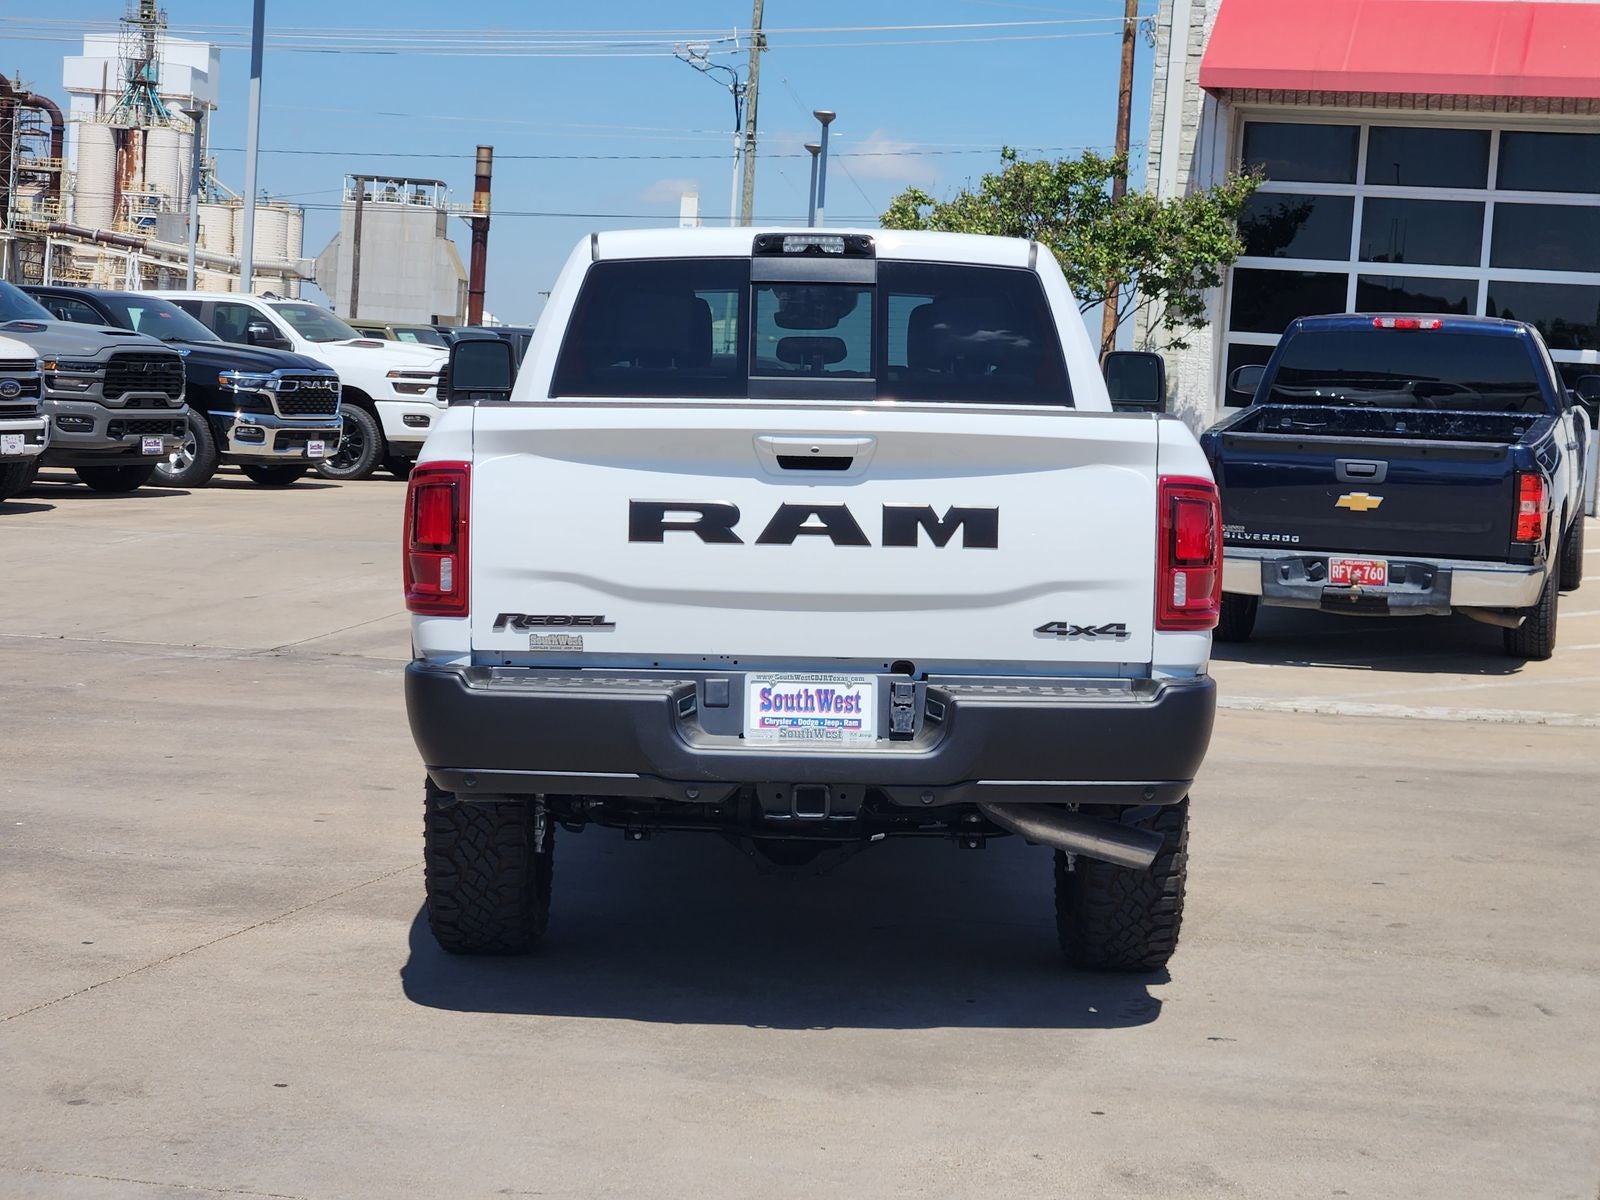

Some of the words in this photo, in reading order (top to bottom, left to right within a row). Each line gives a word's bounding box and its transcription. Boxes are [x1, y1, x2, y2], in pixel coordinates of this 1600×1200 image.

[628, 497, 1000, 550] RAM
[1223, 531, 1300, 543] SILVERADO
[1332, 565, 1352, 579] RFY
[1363, 566, 1384, 581] 760
[492, 612, 617, 632] REBEL
[1033, 621, 1132, 641] 4x4
[529, 633, 583, 646] SouthWest
[759, 687, 862, 714] SouthWest
[764, 718, 793, 727] Chrysler
[797, 718, 819, 728] Dodge
[824, 719, 840, 728] Jeep
[843, 719, 859, 727] Ram
[779, 728, 843, 740] SouthWest
